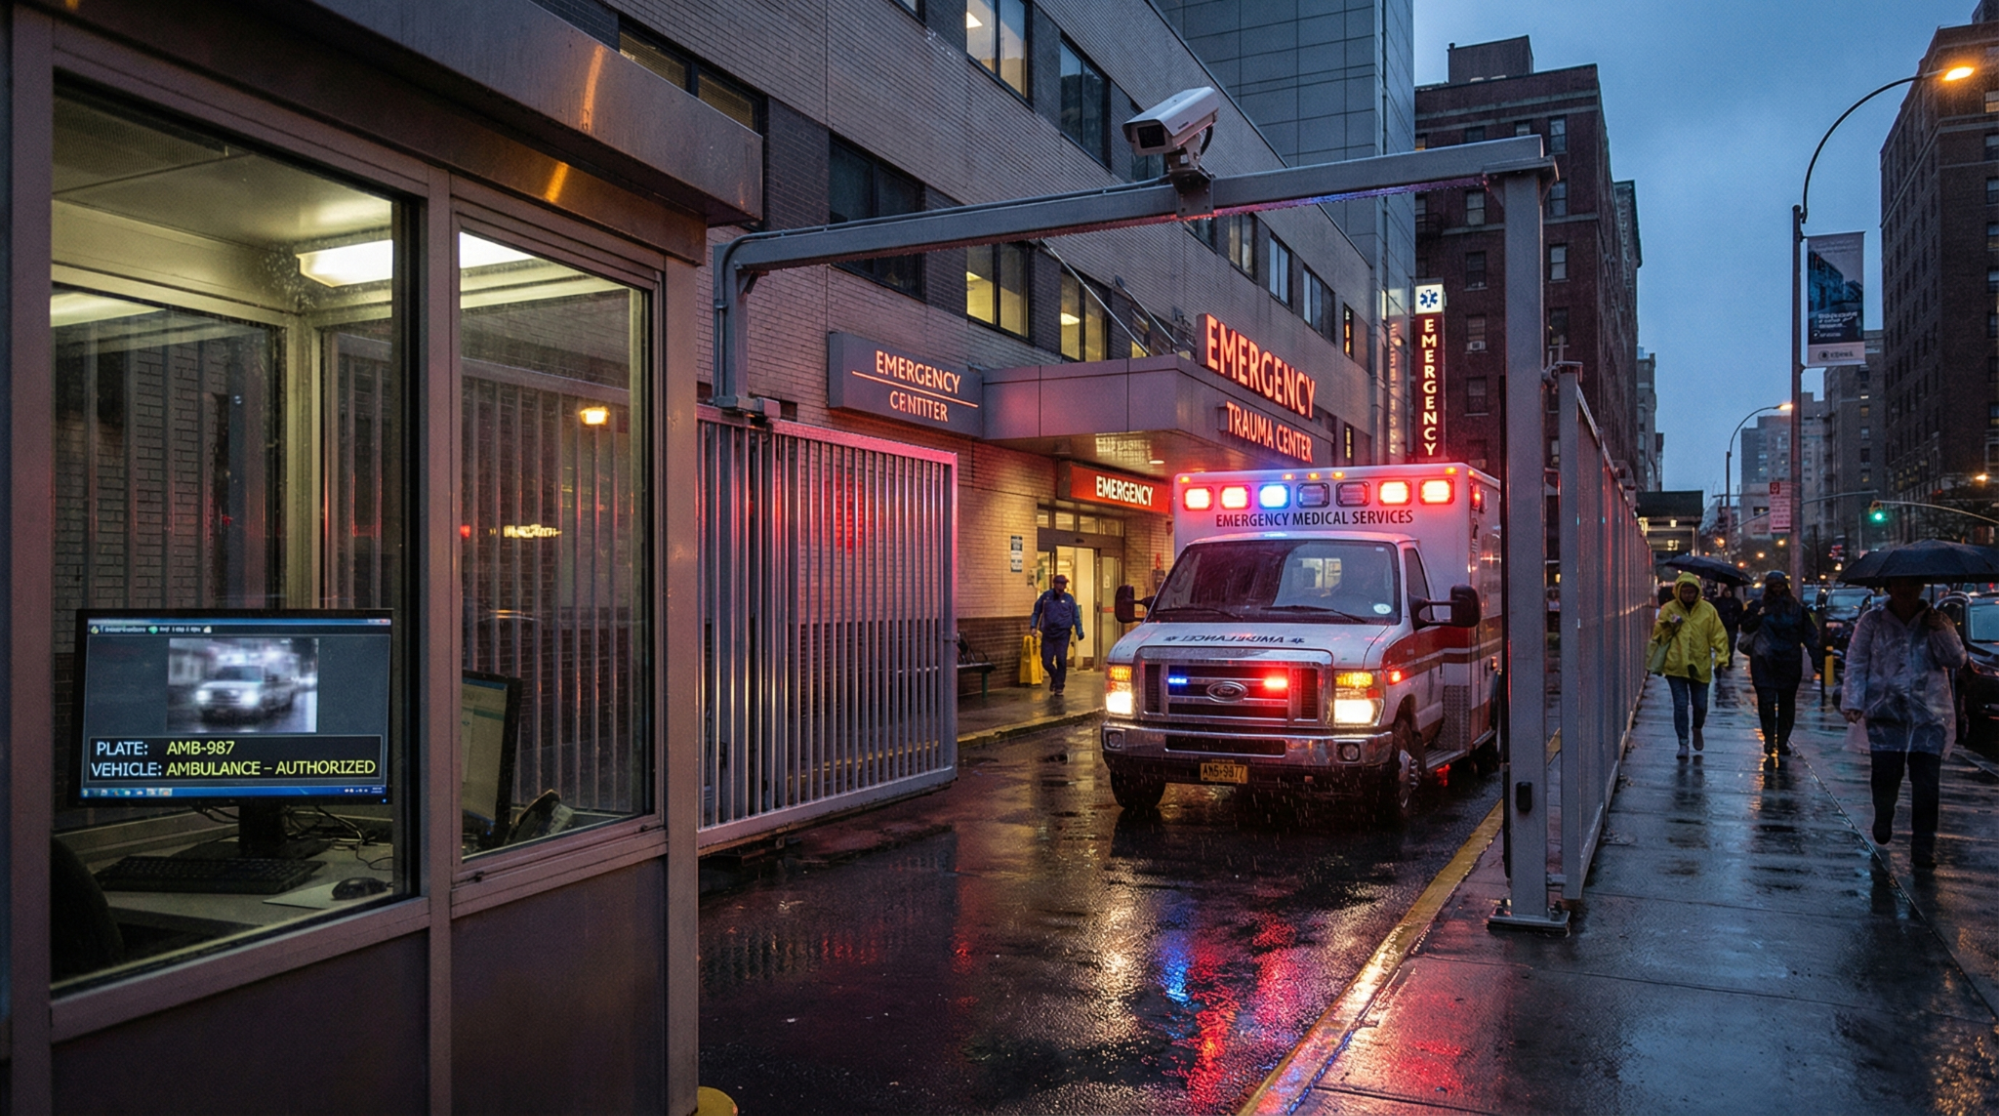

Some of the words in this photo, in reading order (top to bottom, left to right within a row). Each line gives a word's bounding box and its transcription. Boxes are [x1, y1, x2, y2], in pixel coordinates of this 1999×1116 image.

[876, 350, 961, 394] EMERGENCY
[1206, 313, 1316, 419] EMERGENCY
[1421, 318, 1437, 456] EMERGENCY
[1226, 400, 1275, 449] TRAUMA
[1276, 423, 1313, 463] CENTER
[1096, 475, 1154, 507] EMERGENCY
[1216, 513, 1290, 528] EMERGENCY
[1292, 511, 1349, 526] MEDICAL
[1352, 509, 1414, 525] SERVICES
[96, 742, 149, 756] PLATE:
[166, 741, 236, 755] AMB-987
[91, 762, 162, 777] VEHICLE:
[166, 761, 261, 777] AMBULANCE
[275, 760, 376, 775] AUTHORIZED
